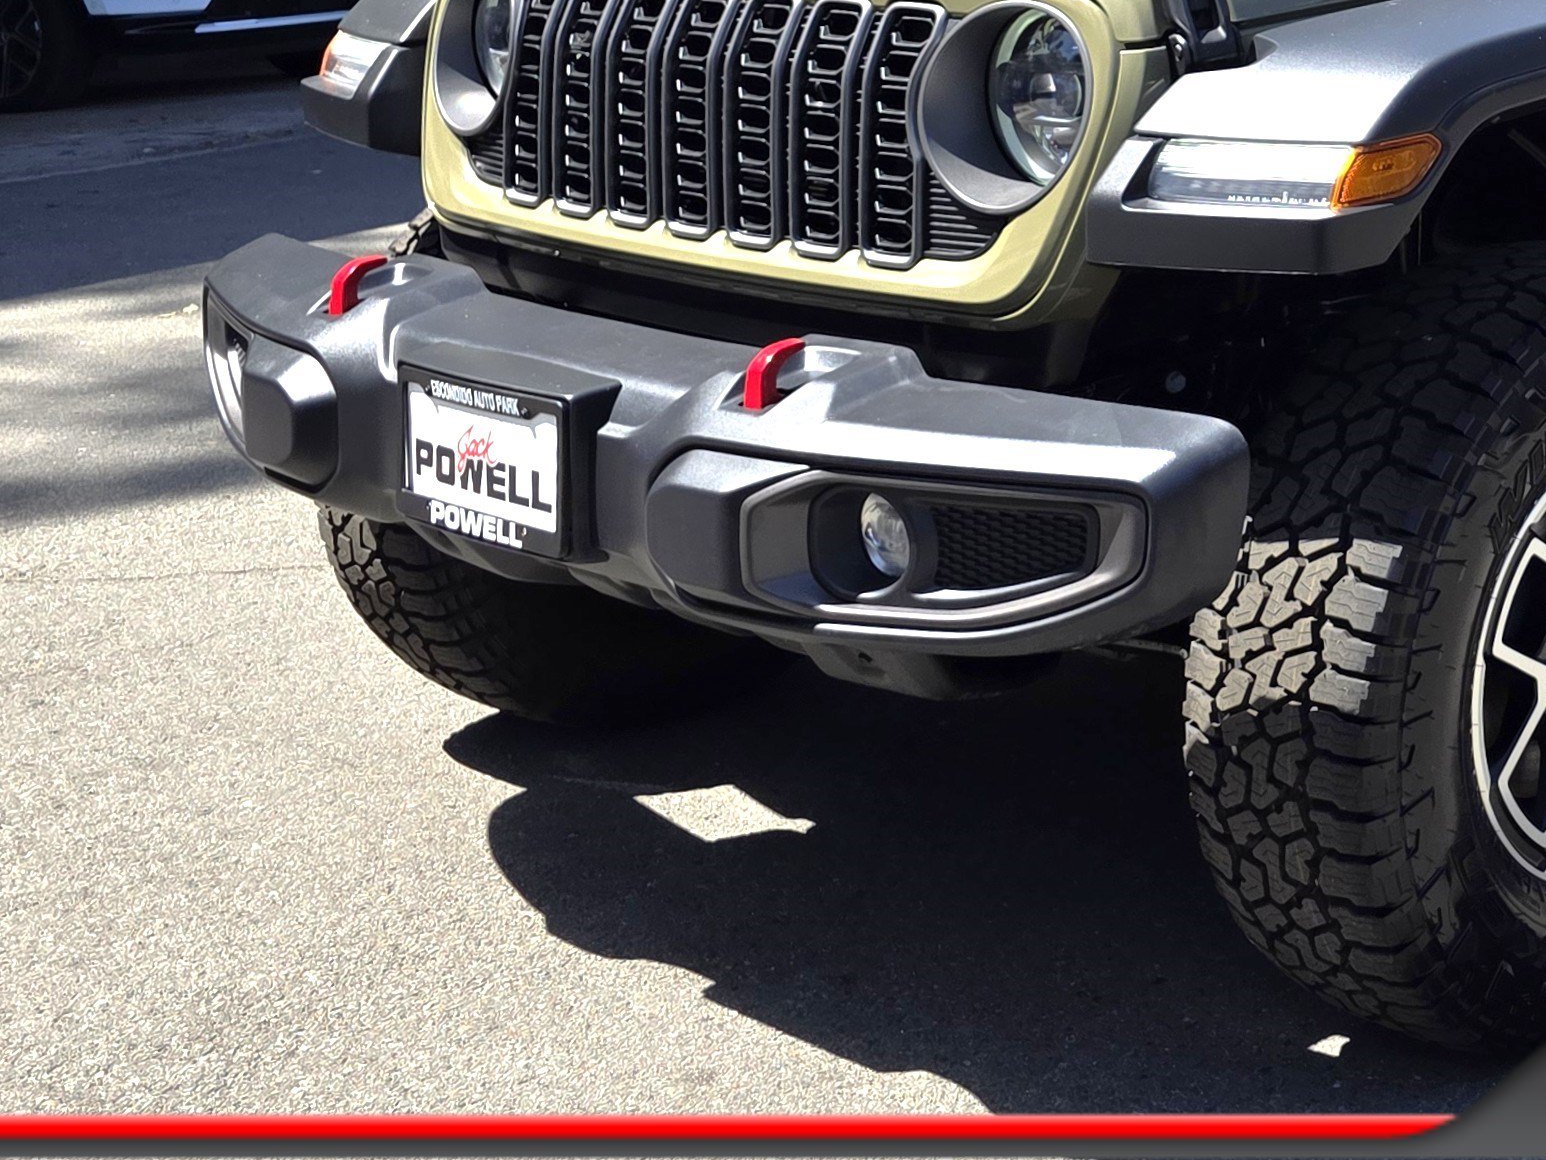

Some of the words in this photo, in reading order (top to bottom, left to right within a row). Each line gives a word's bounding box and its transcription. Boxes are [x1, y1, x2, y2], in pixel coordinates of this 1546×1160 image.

[431, 379, 473, 406] ESCONDIDO
[473, 390, 496, 411] AUTO
[495, 394, 520, 416] PARK
[457, 425, 496, 472] Jack
[415, 438, 552, 514] POWELL
[429, 500, 523, 549] POWELL
